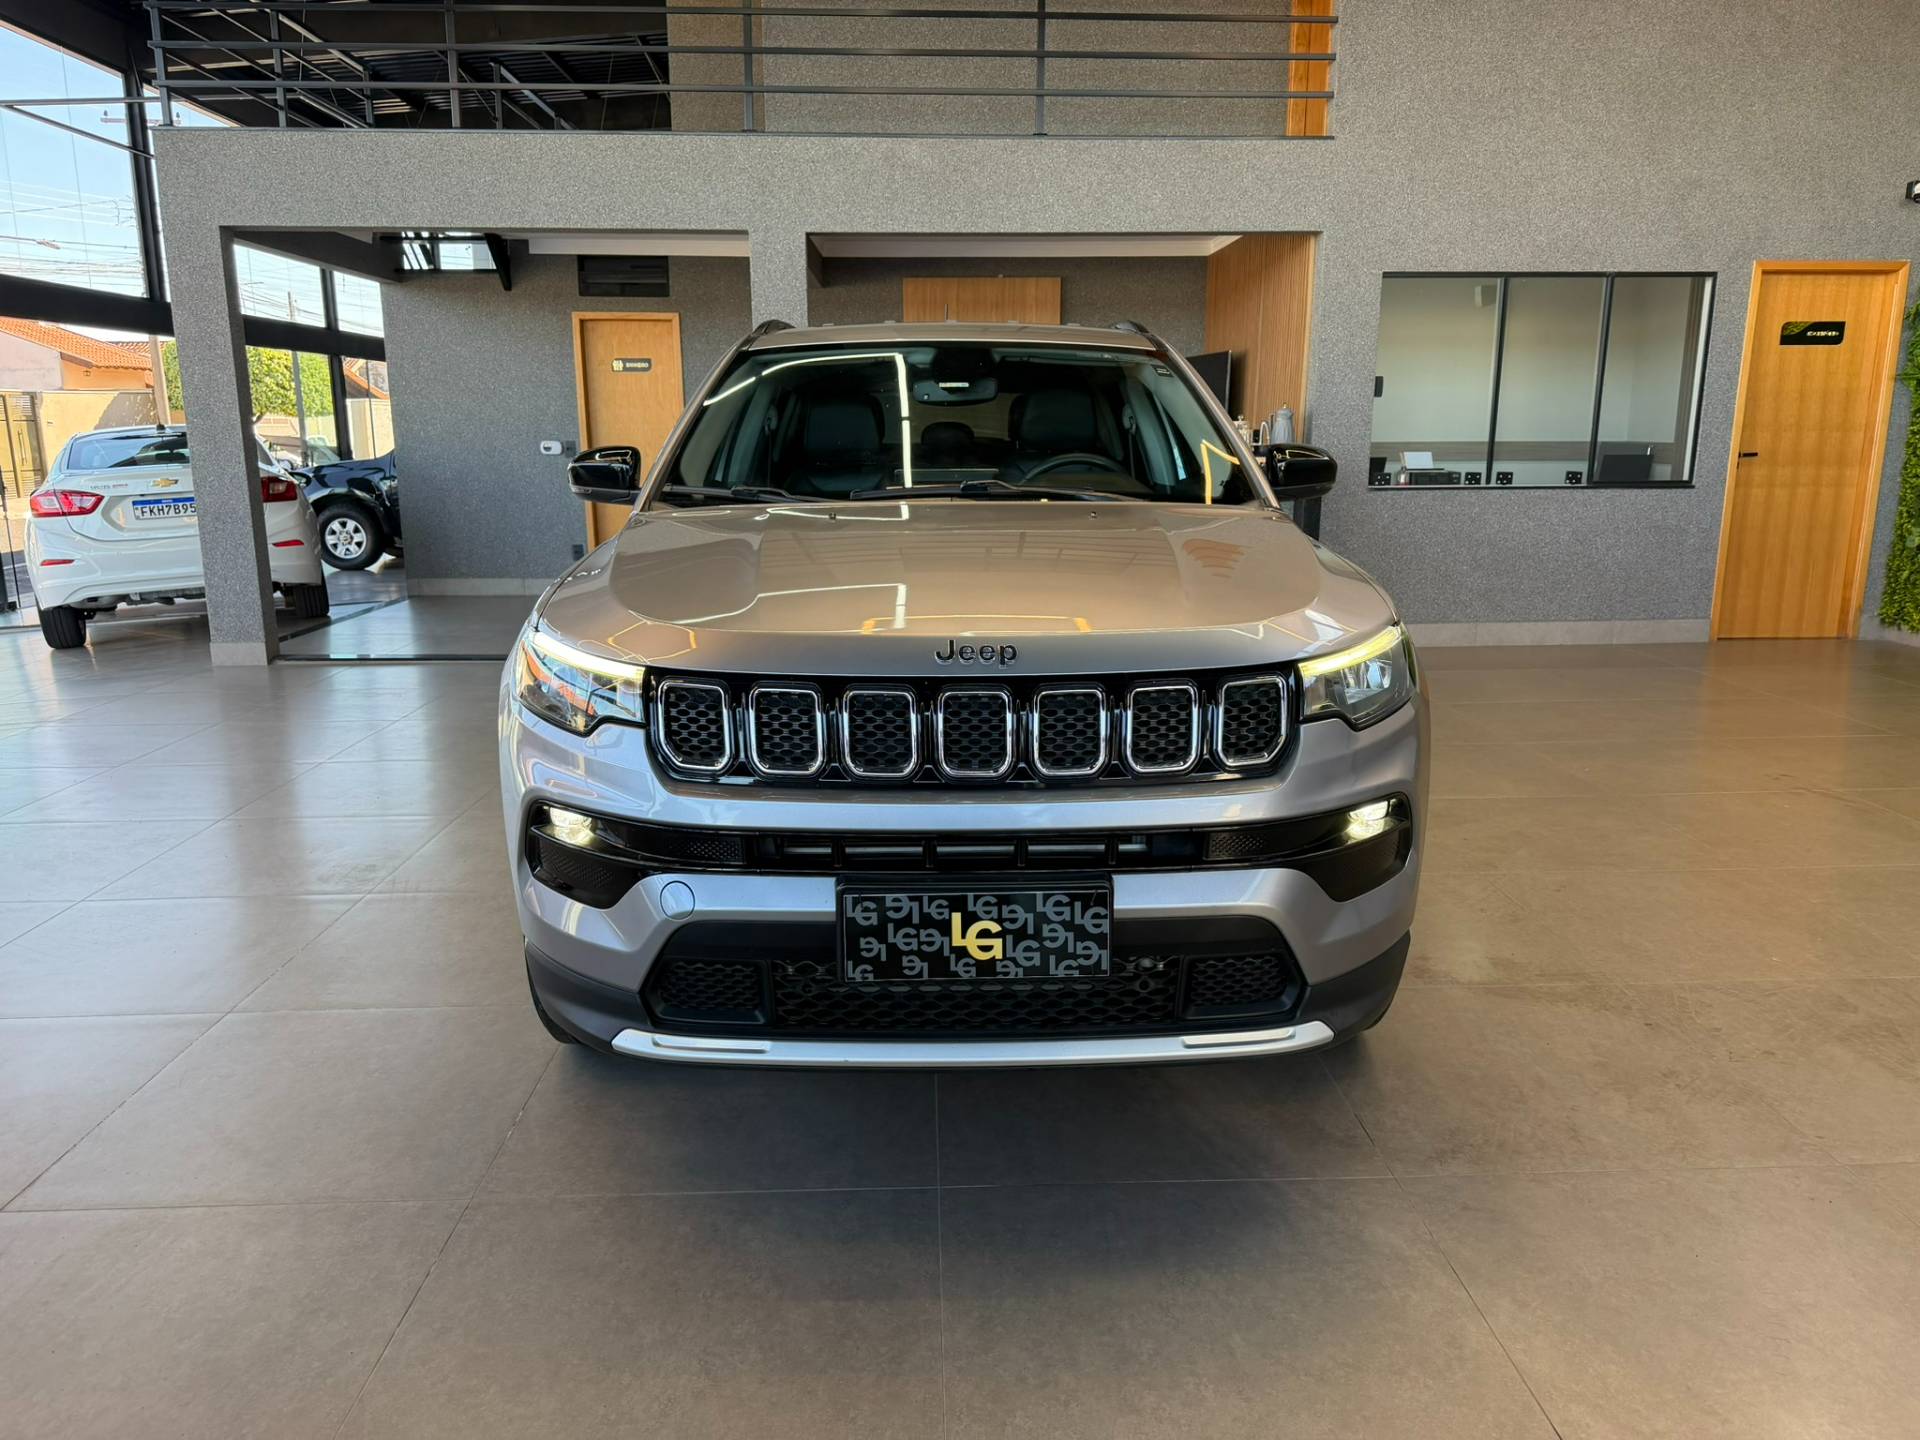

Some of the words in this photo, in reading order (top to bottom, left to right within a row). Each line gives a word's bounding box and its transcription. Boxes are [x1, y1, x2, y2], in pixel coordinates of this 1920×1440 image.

[140, 503, 197, 517] FKH7B95
[935, 639, 1018, 667] Jeep
[951, 912, 1003, 960] LG
